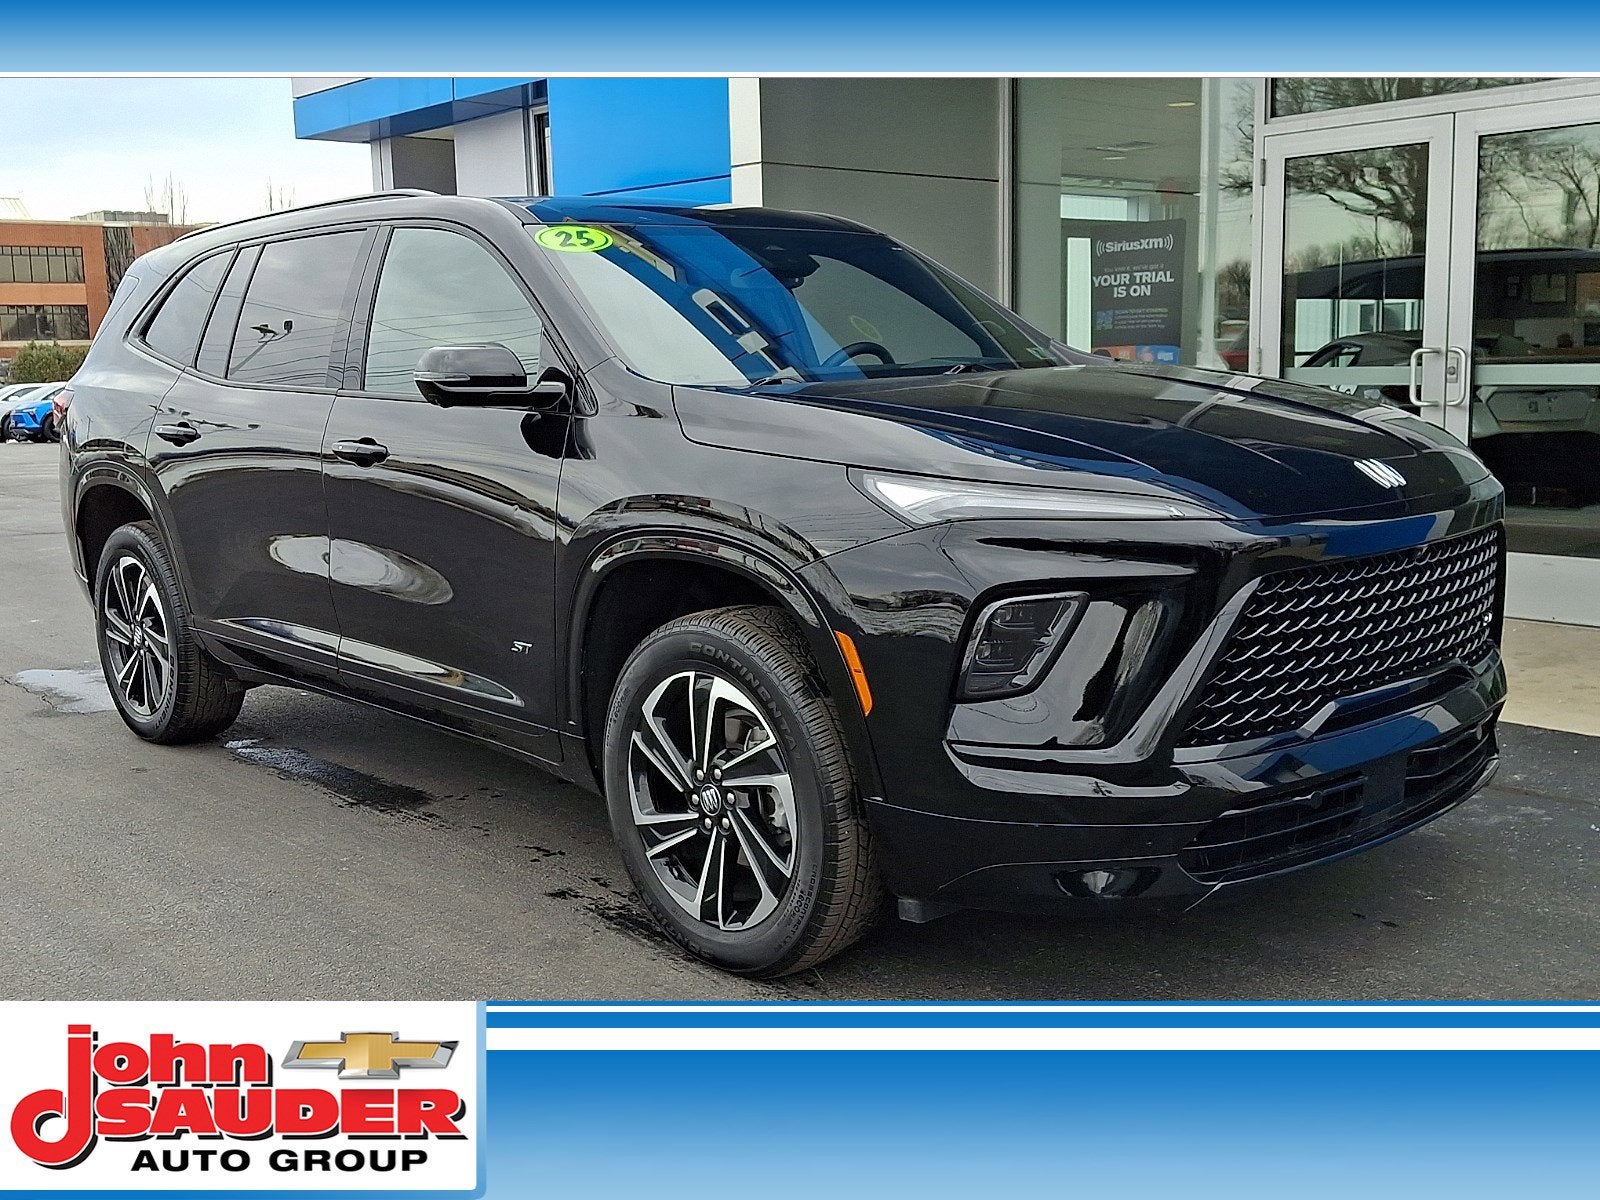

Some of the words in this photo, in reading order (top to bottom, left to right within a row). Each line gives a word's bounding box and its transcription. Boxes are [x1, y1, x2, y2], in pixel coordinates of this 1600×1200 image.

[554, 230, 596, 248] 25
[1092, 273, 1130, 287] YOUR
[1133, 270, 1175, 284] TRIAL
[1113, 286, 1127, 298] IS
[1129, 284, 1151, 297] ON
